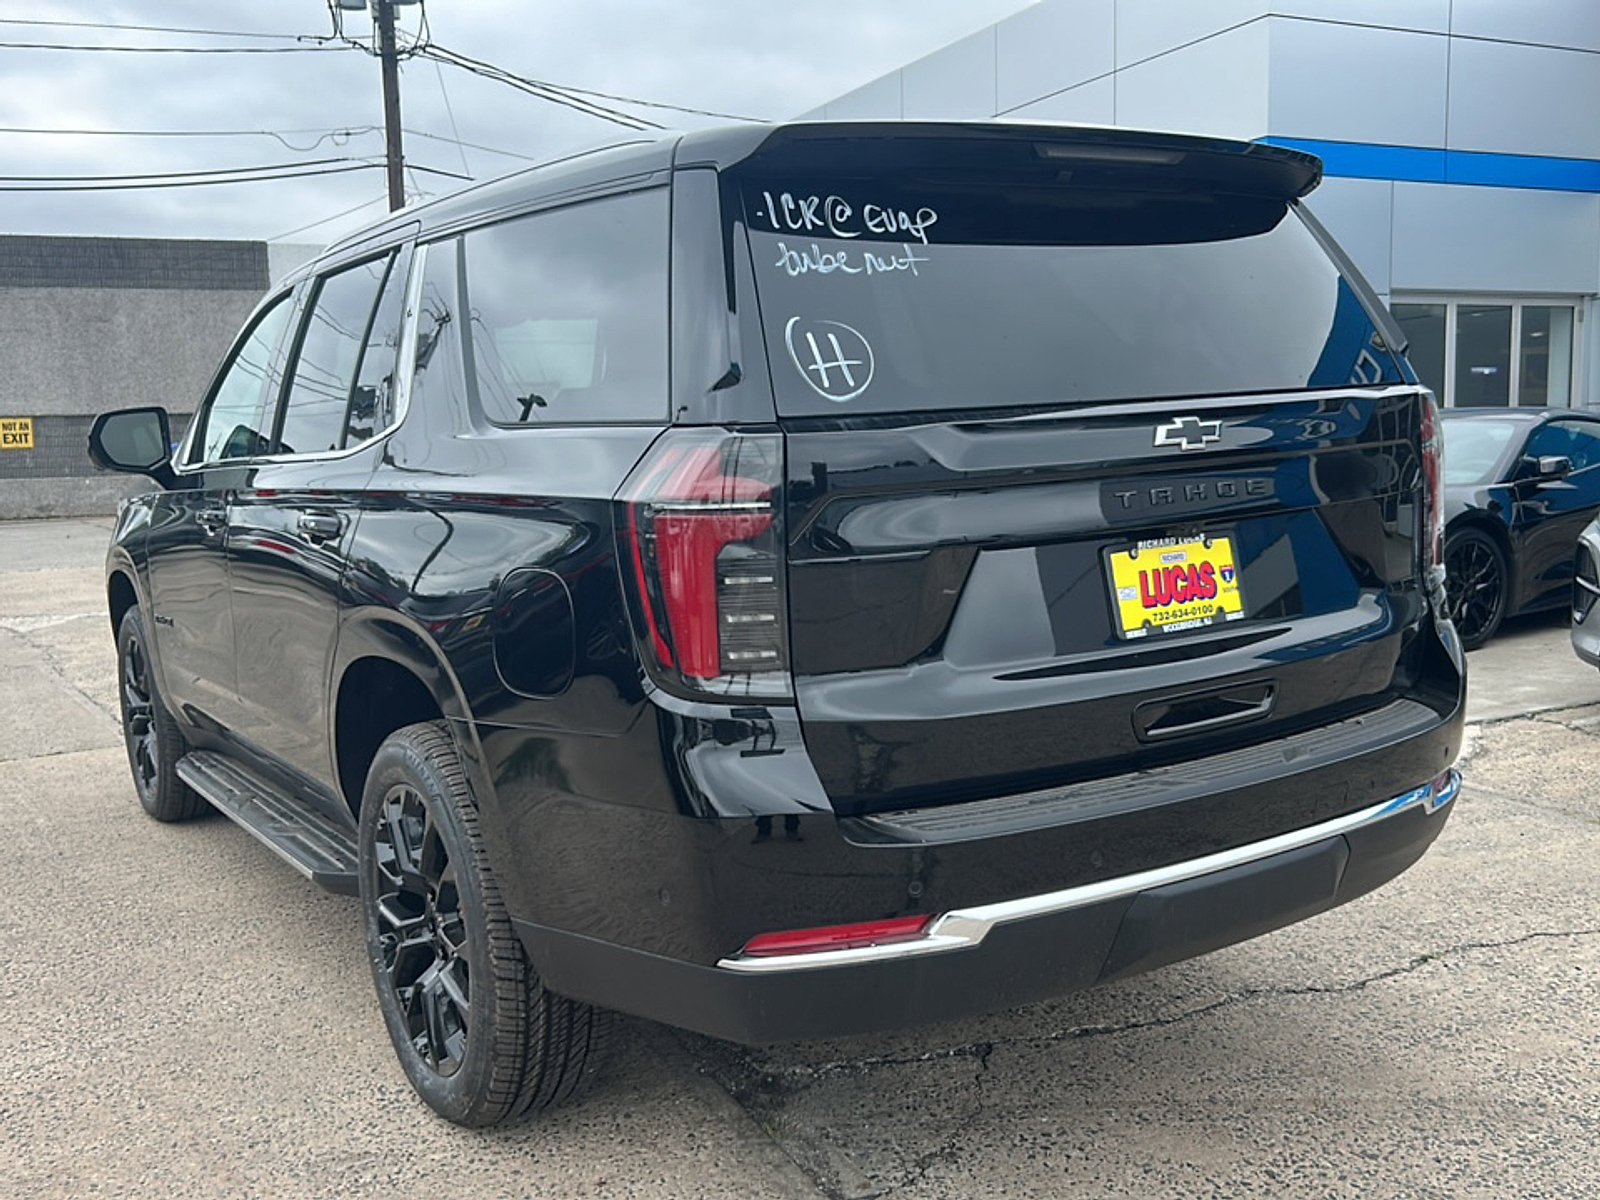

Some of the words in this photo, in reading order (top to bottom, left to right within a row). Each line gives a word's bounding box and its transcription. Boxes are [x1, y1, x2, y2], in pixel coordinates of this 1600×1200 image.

[806, 331, 863, 388] H
[3, 433, 29, 444] EXIT
[1113, 479, 1269, 509] TAHOE
[1139, 560, 1218, 609] LUCAS
[1152, 604, 1214, 622] 732-634-0100
